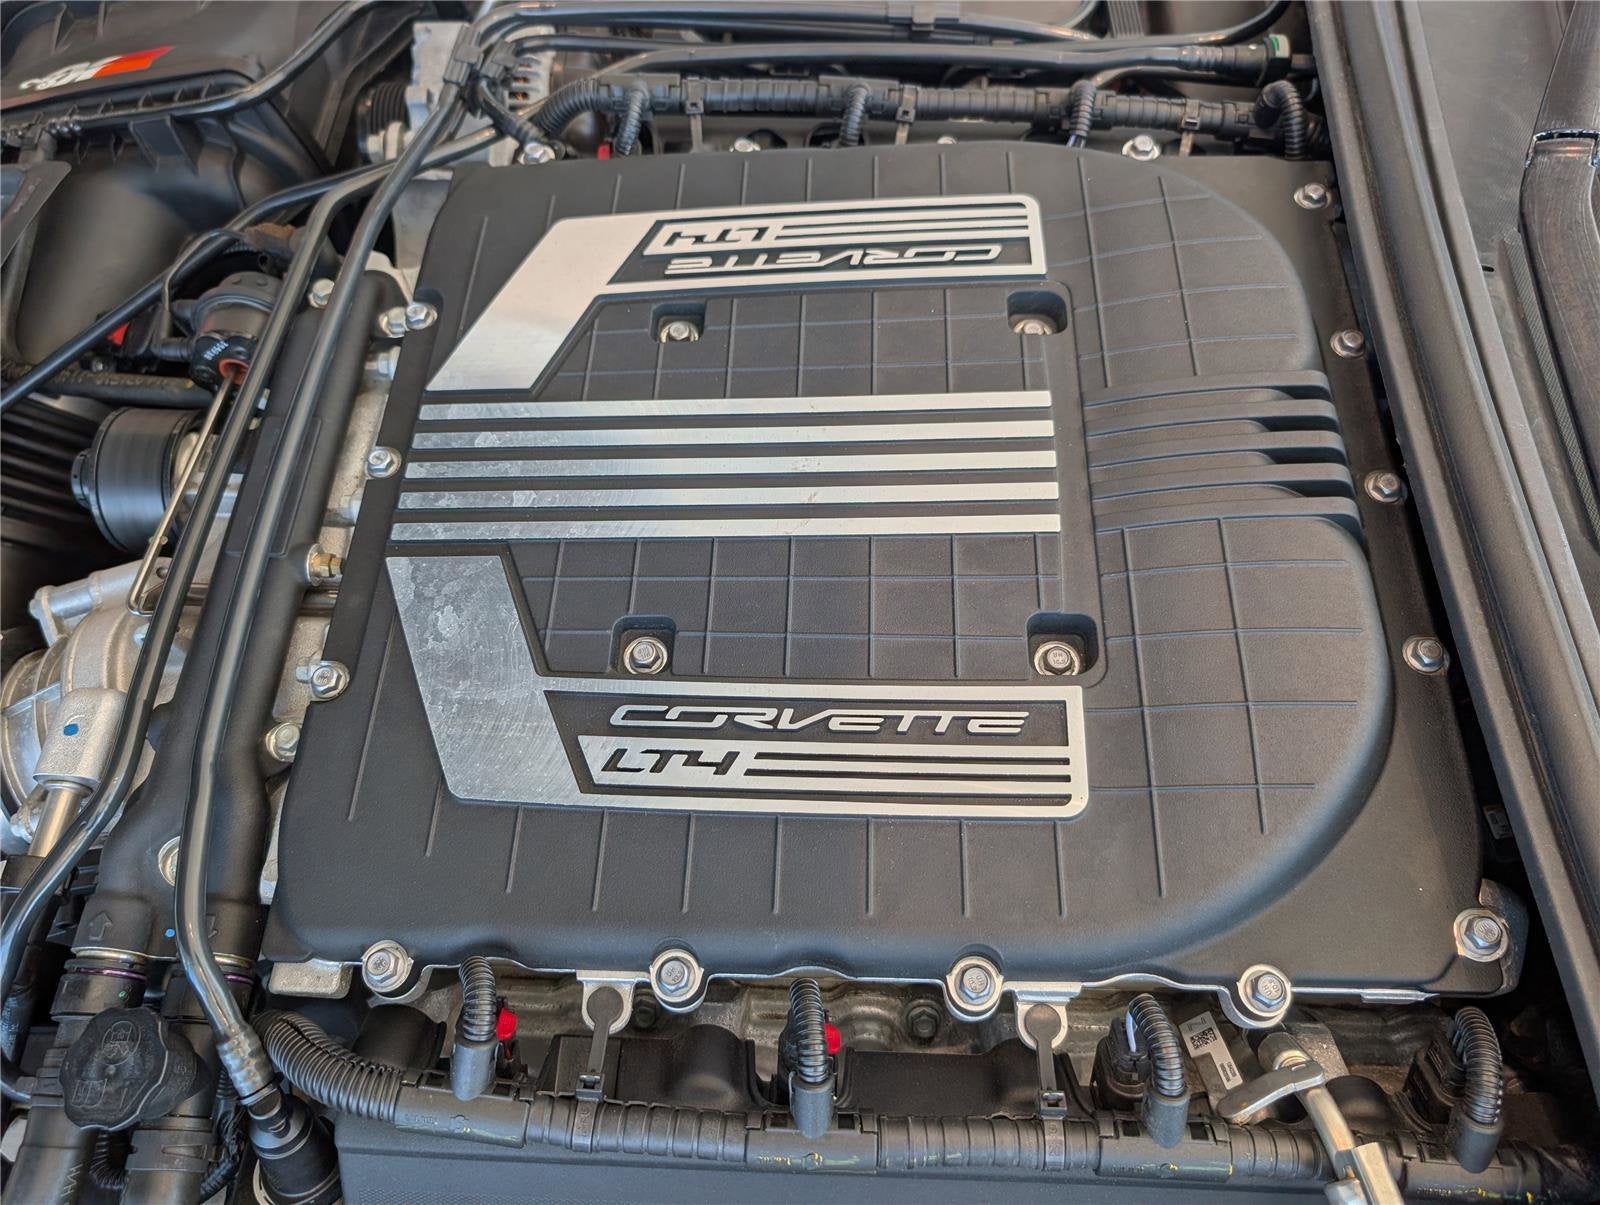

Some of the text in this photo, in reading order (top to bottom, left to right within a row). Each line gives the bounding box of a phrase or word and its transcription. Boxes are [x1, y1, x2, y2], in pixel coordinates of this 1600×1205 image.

[663, 227, 771, 247] LT4
[664, 244, 1003, 275] CORVETTE
[609, 704, 1030, 734] CORVETTE
[601, 747, 740, 776] LT4
